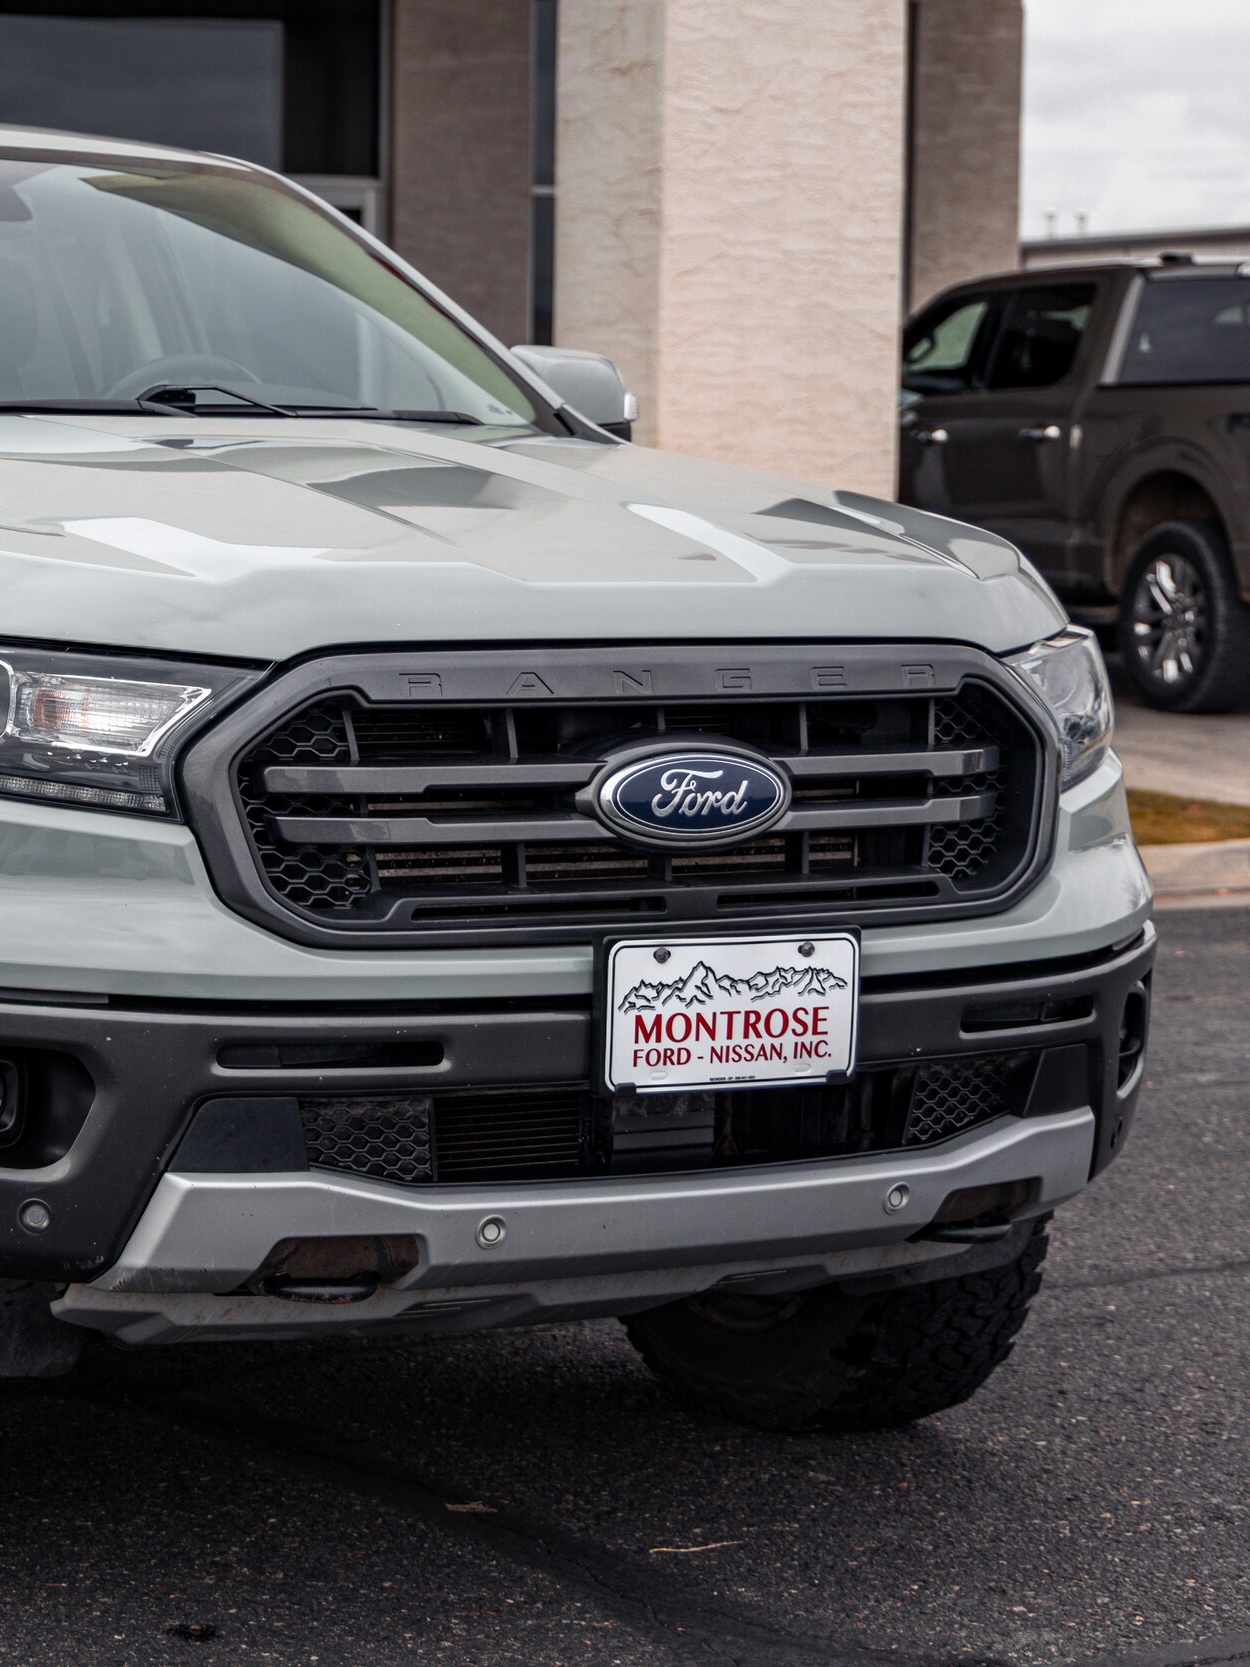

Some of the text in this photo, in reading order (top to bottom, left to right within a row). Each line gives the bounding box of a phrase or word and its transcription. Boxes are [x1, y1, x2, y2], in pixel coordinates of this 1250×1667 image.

[399, 663, 936, 697] RANGER
[651, 768, 748, 818] Ford
[633, 1006, 830, 1044] MONTROSE
[632, 1048, 692, 1068] FORD
[710, 1043, 788, 1064] NISSAN,
[793, 1040, 832, 1060] INC.
